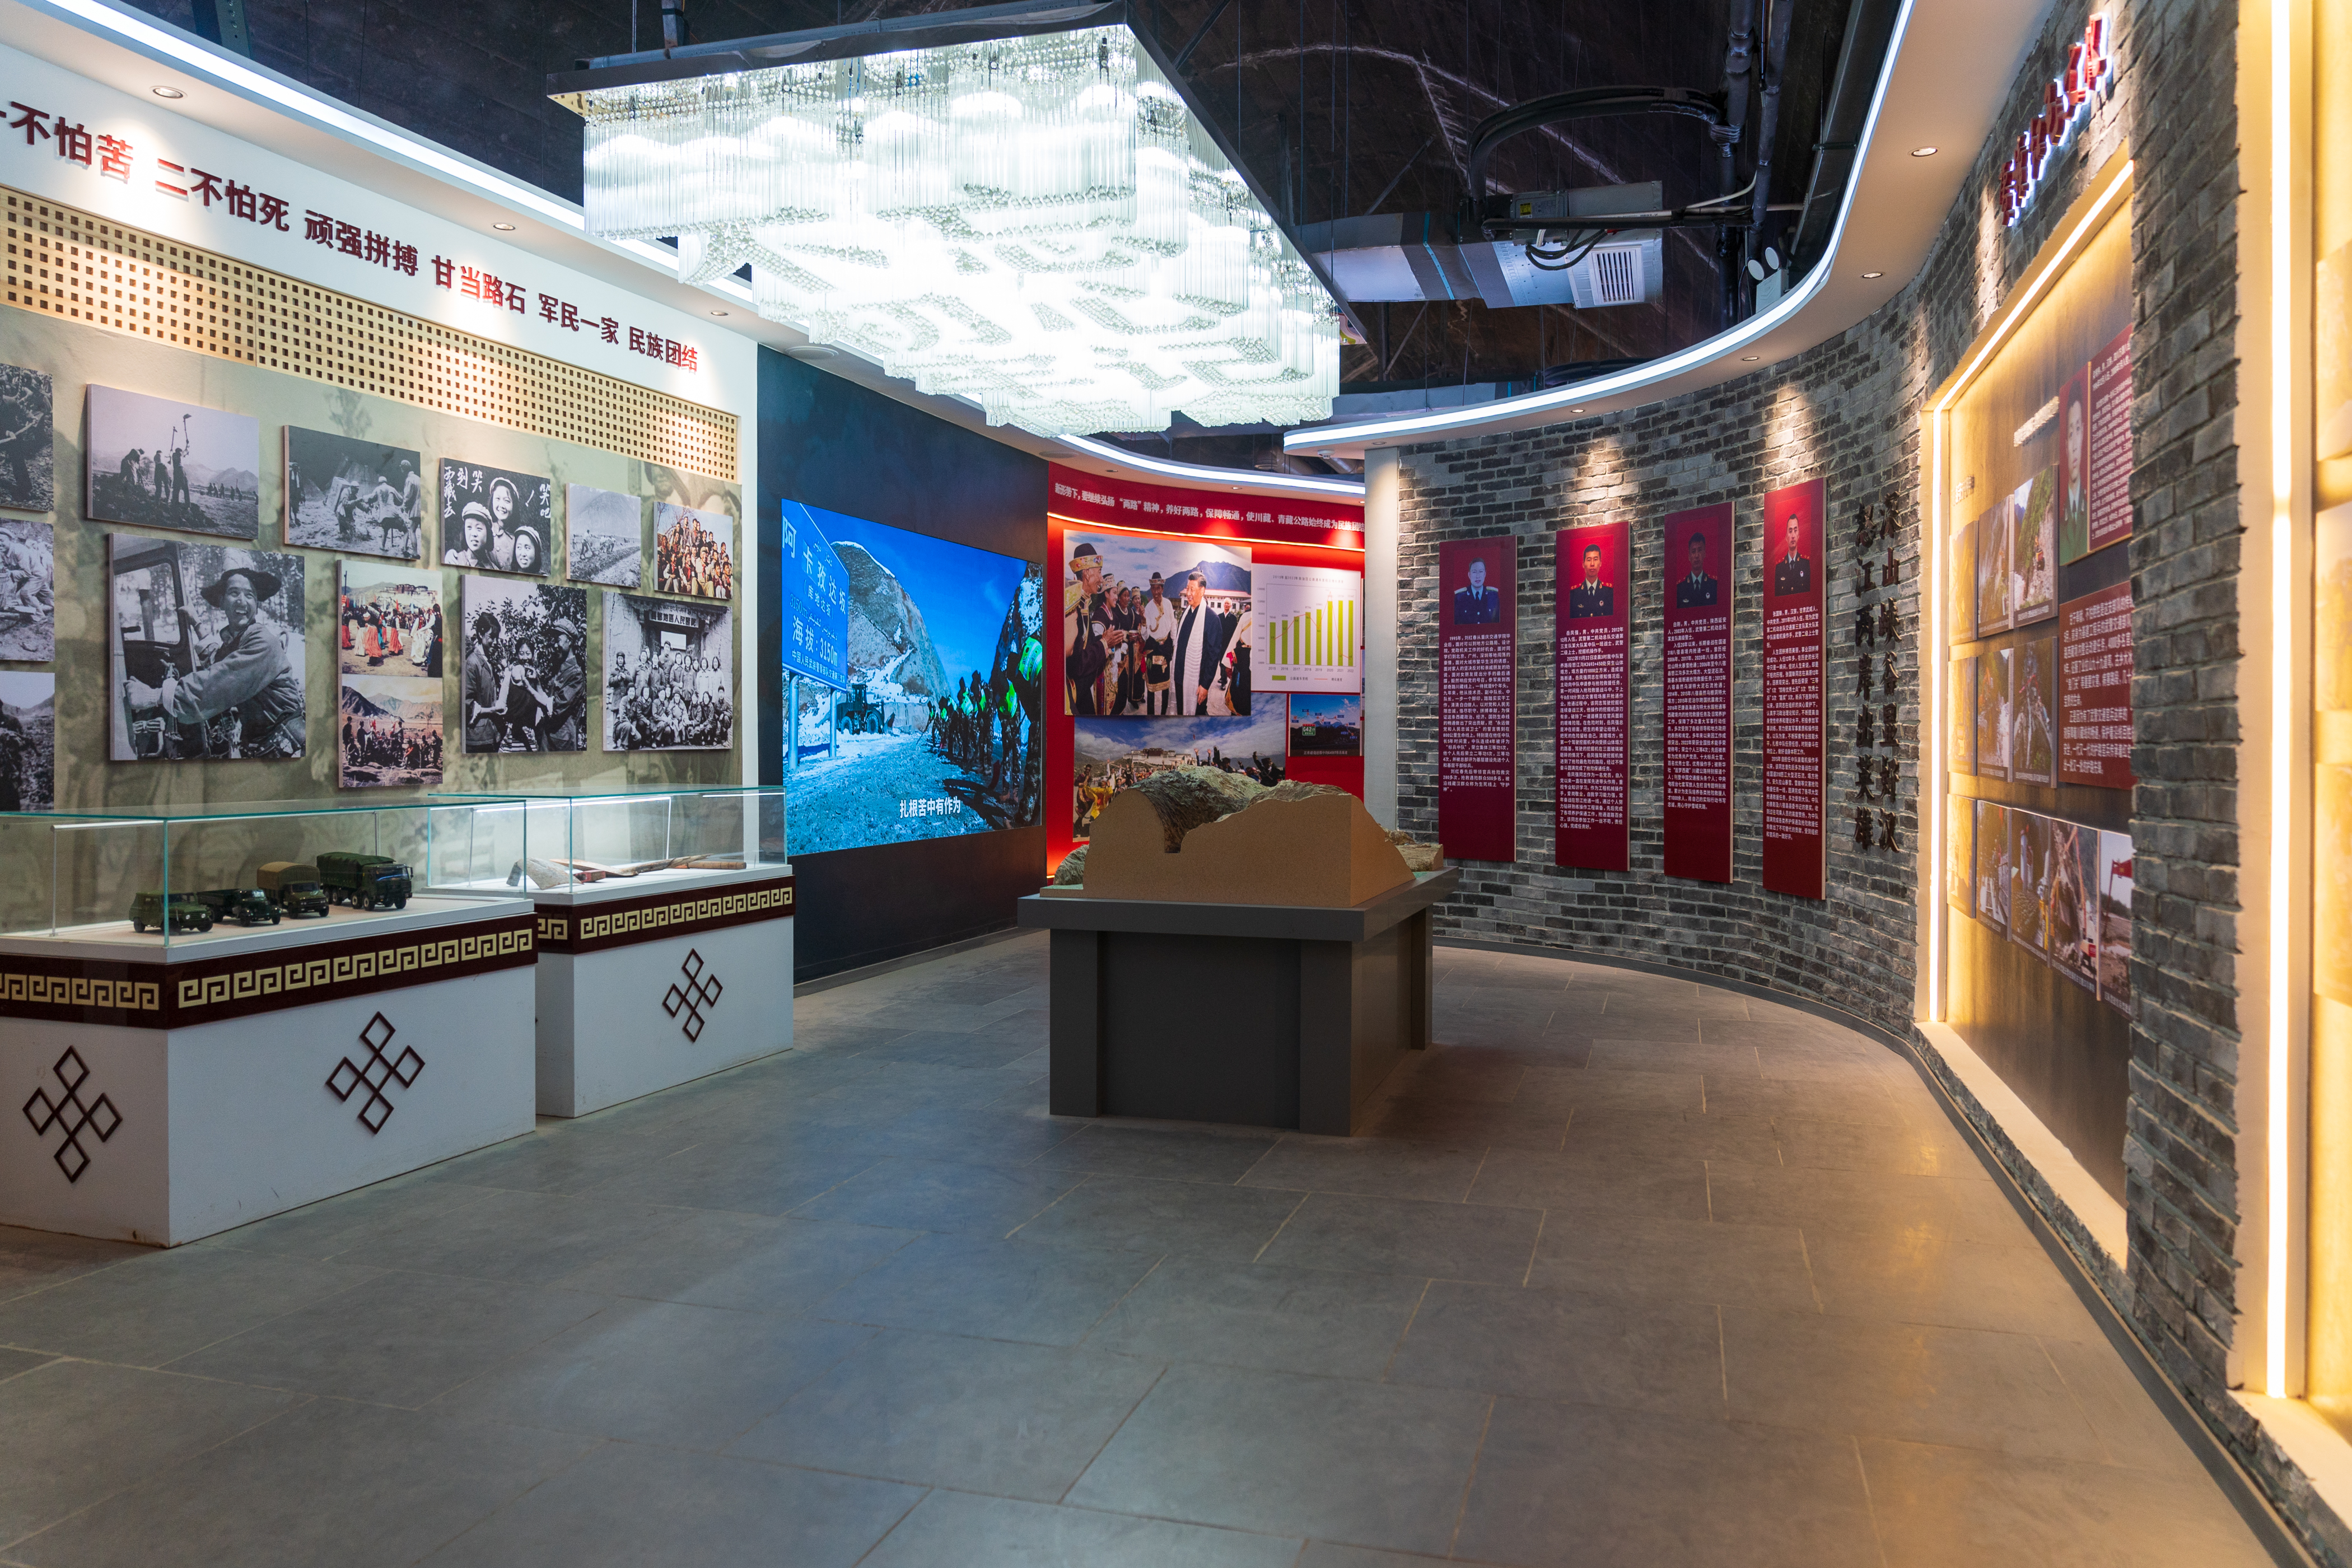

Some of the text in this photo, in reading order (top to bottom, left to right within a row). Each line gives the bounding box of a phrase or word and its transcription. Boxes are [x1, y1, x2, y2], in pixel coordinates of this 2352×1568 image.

[0, 101, 698, 374] 不怕苦 二不怕死 顽强拼搏 甘当路石 军民一家 民族团结
[899, 796, 961, 819] 扎根苦中有作为
